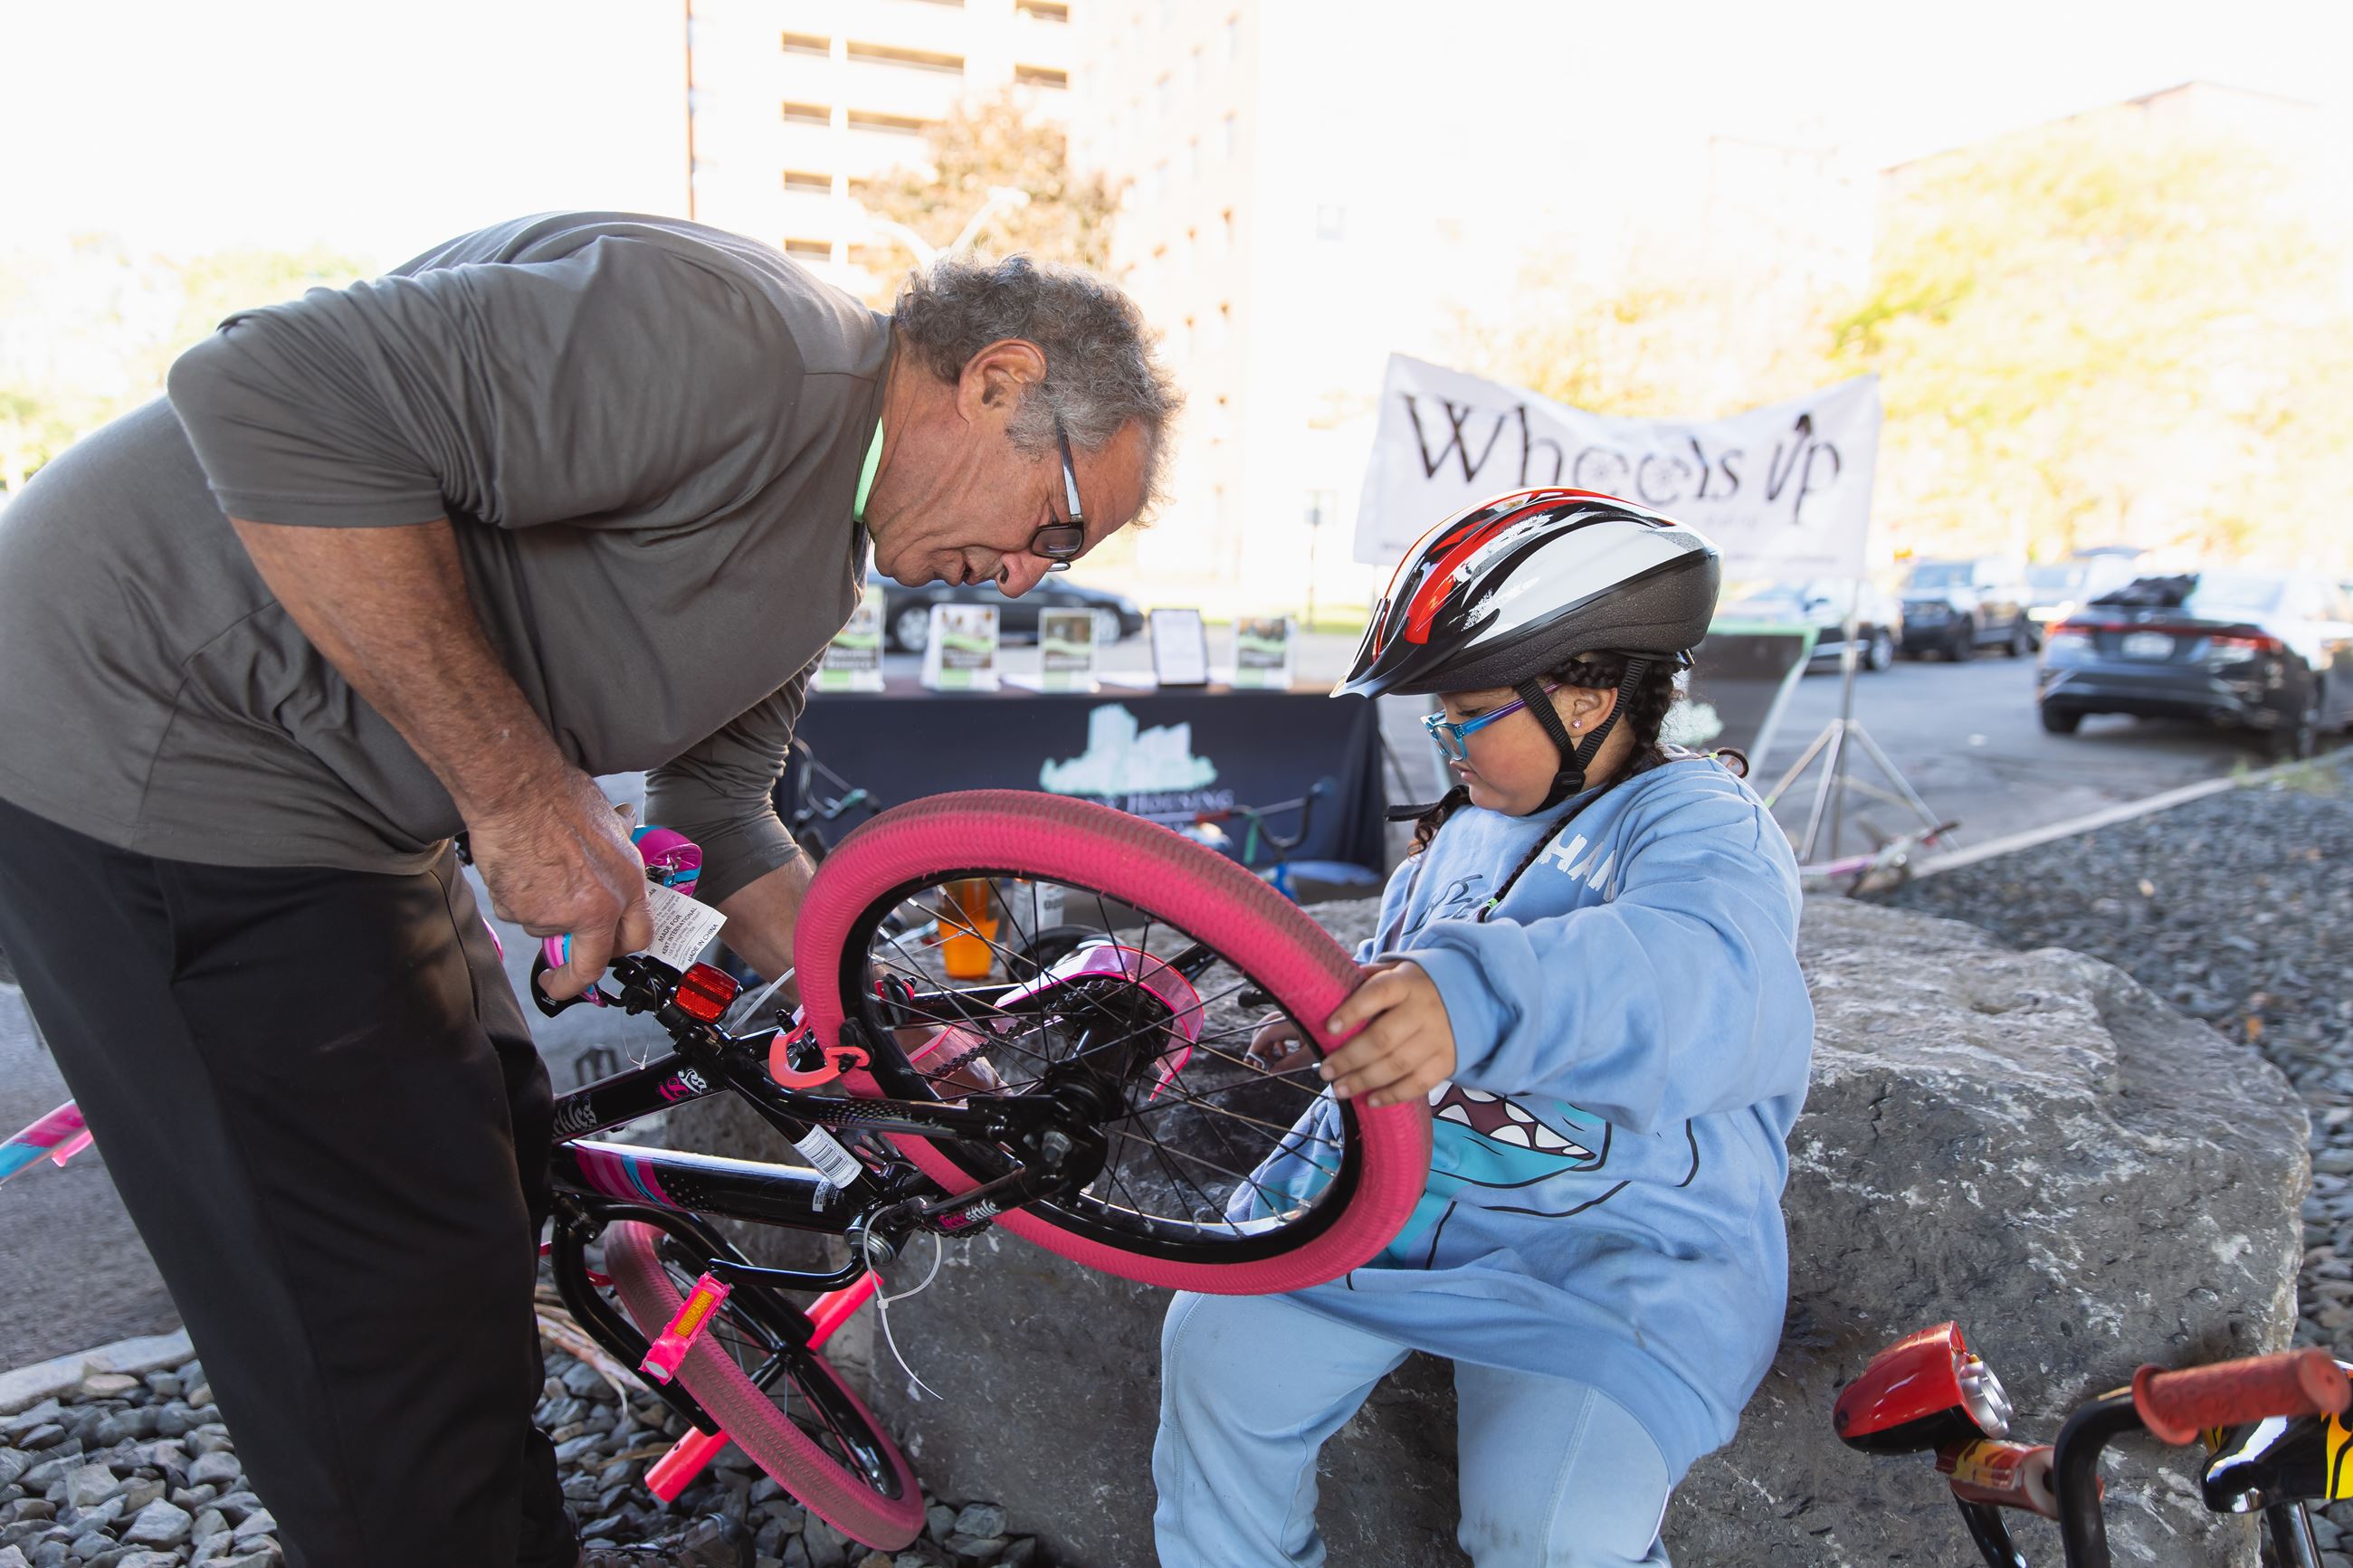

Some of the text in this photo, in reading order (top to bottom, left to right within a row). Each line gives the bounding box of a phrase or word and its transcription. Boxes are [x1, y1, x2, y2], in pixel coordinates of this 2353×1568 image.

[1394, 391, 1745, 506] Wheels
[658, 914, 681, 942] MADE FOR
[662, 906, 697, 954] KENT INTERNATIONAL
[675, 926, 689, 942] Highway
[688, 945, 699, 961] MADE
[702, 923, 718, 940] CHINA
